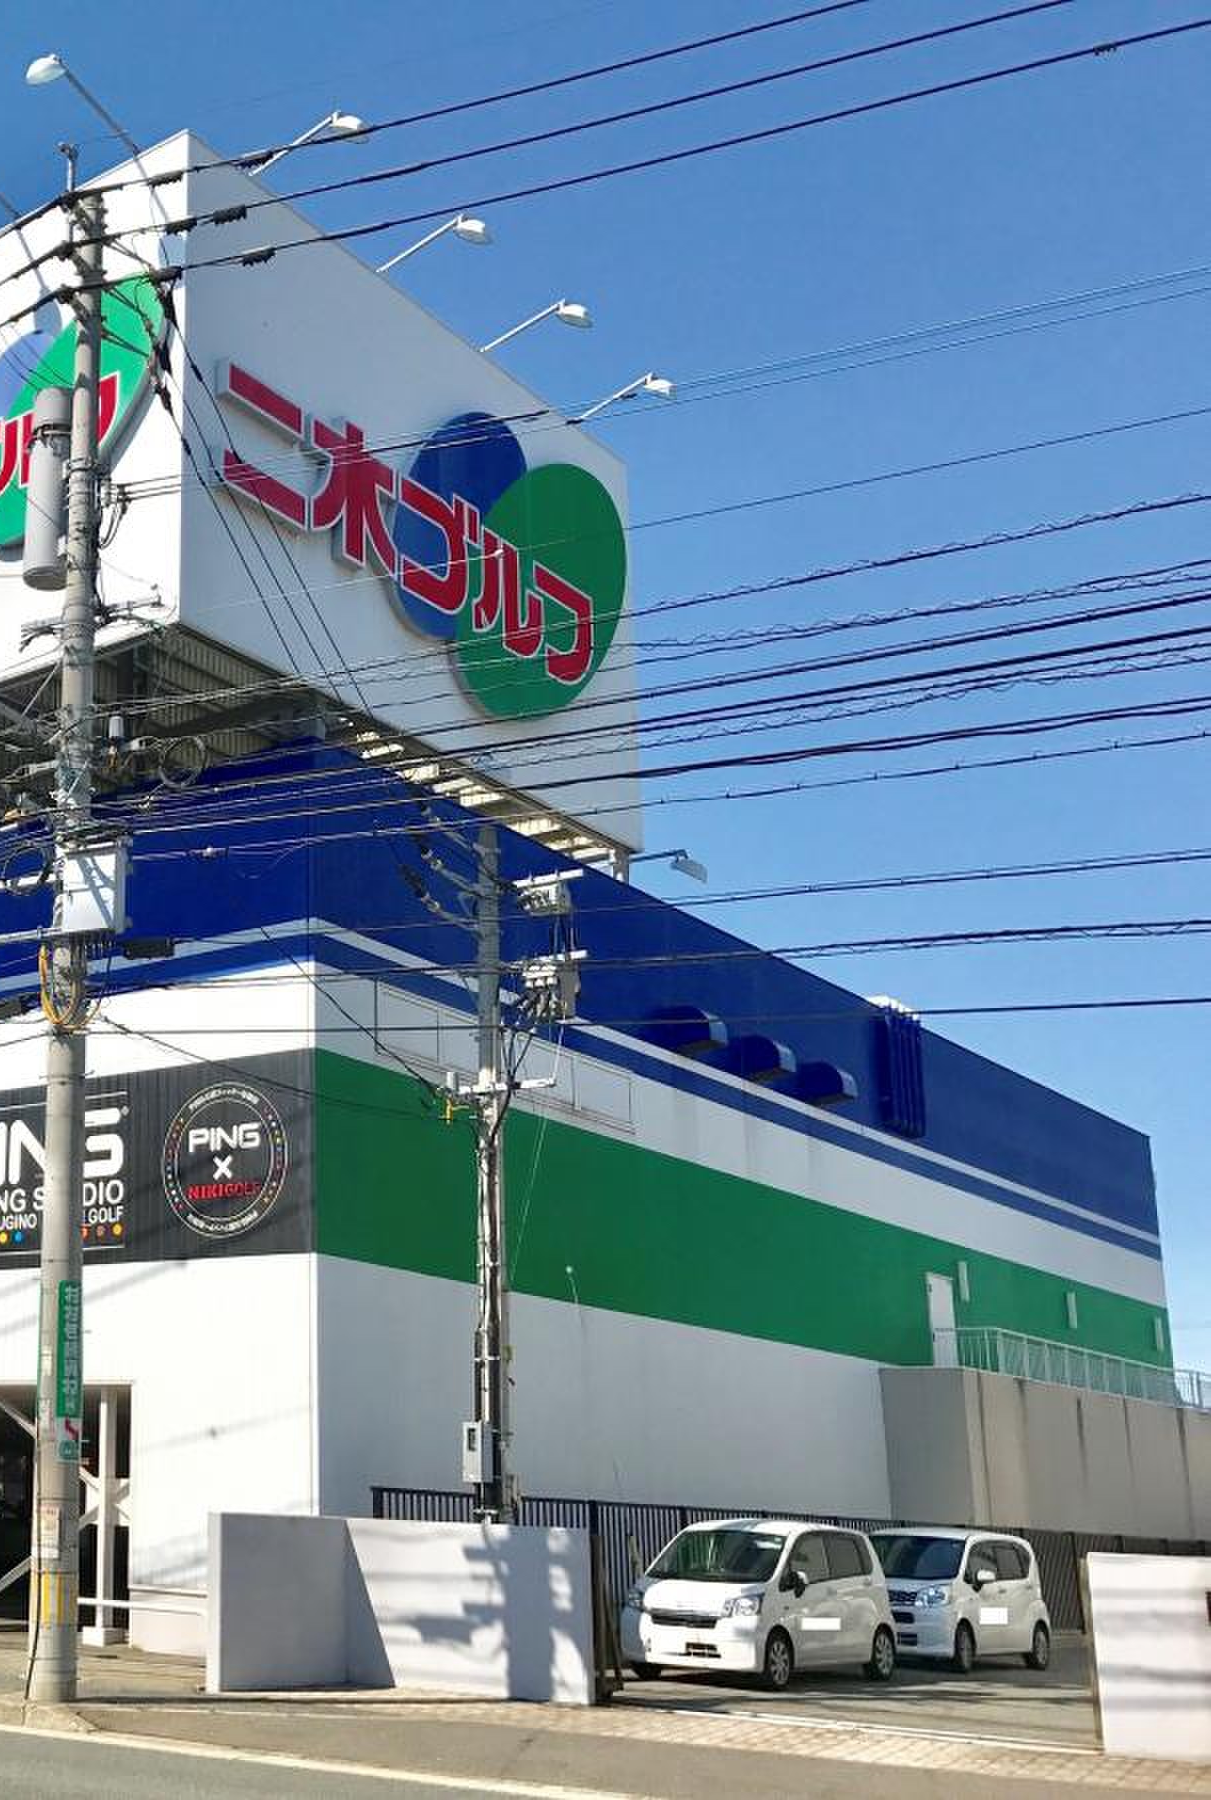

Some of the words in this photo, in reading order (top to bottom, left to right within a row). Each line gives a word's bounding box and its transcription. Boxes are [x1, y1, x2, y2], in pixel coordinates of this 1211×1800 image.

[189, 1122, 262, 1153] PING
[32, 1180, 124, 1212] SDIO
[88, 1206, 124, 1225] GOLF
